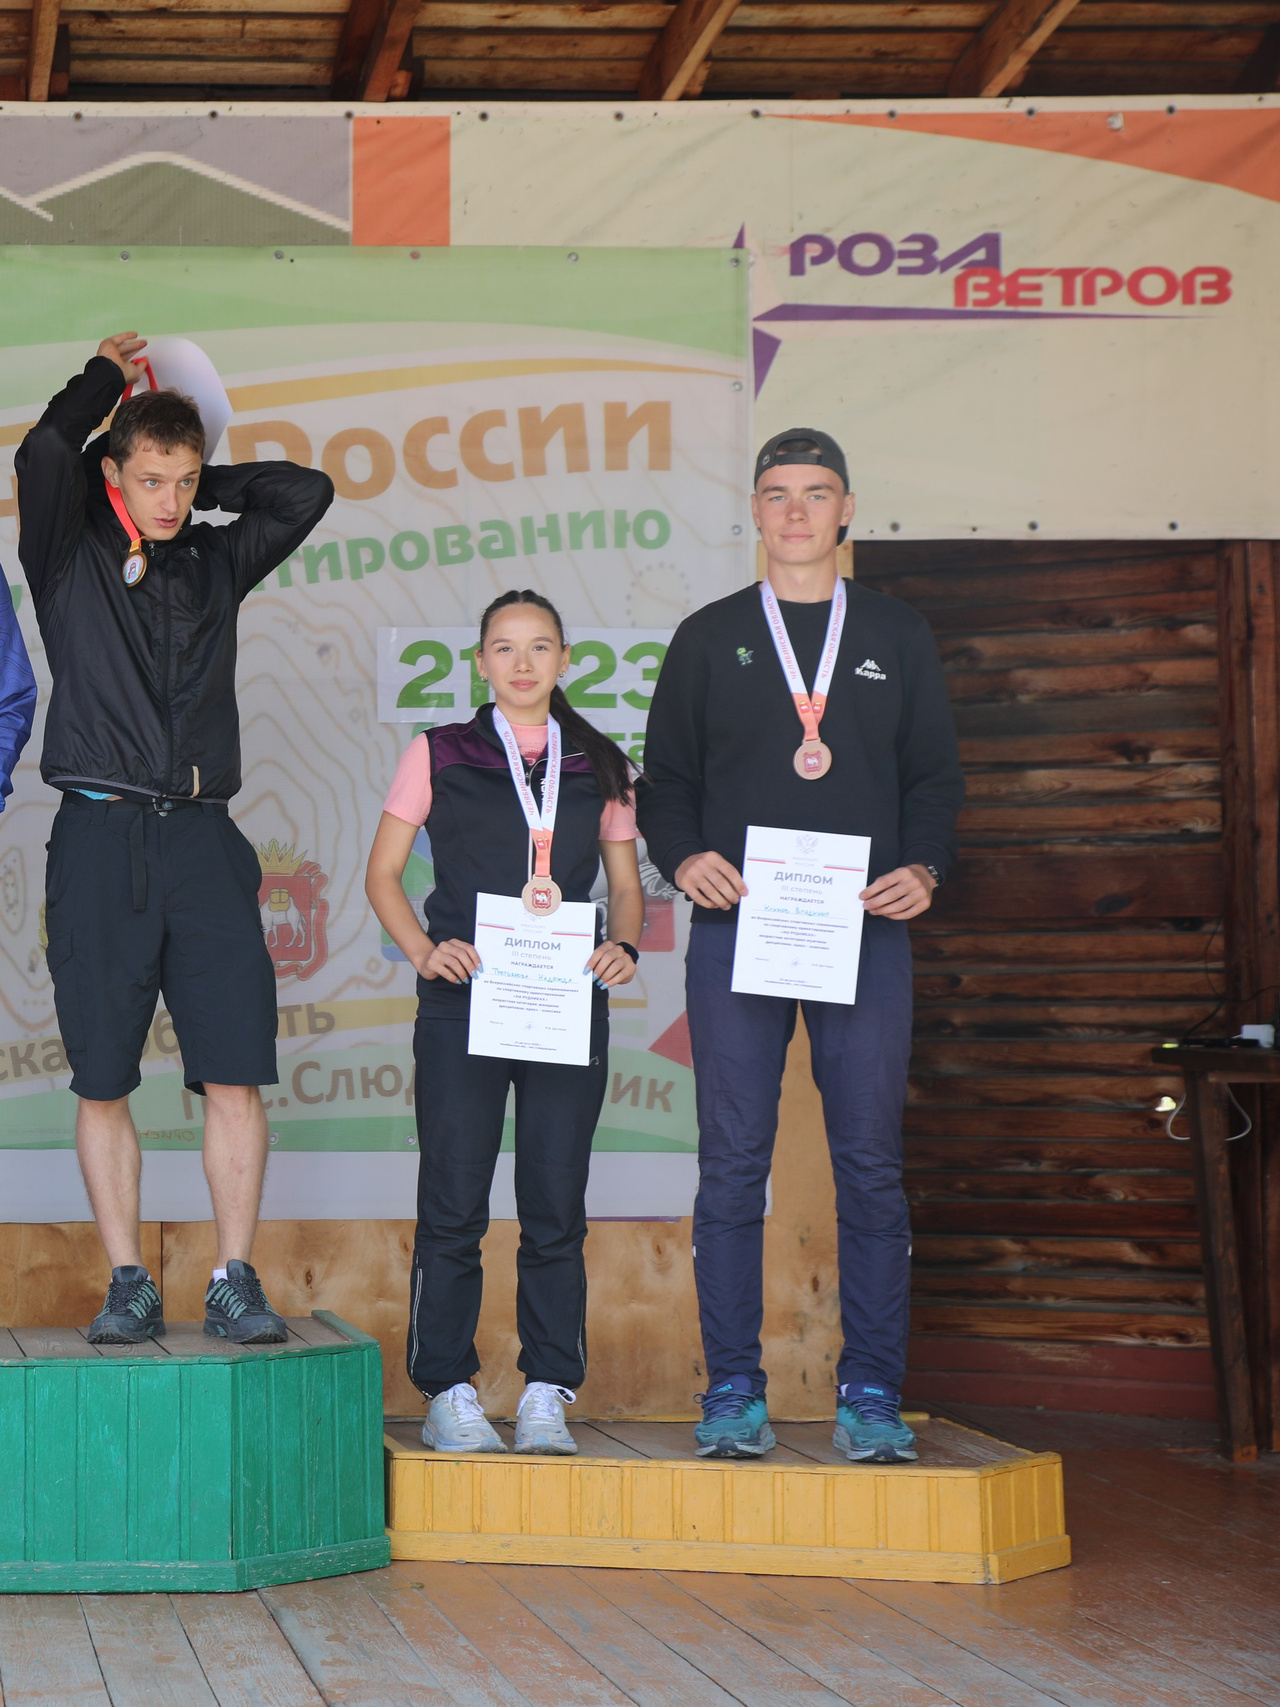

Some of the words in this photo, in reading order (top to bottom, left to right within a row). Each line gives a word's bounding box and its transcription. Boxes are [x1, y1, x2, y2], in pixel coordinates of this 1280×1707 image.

[788, 232, 1000, 276] РОЗА
[952, 266, 1233, 307] ВЕТРОВ
[776, 625, 796, 679] ЧЕЛЯБИНСКАЯ
[822, 643, 835, 678] ОБЛАСТЬ
[855, 666, 886, 680] Kappa
[504, 731, 518, 762] ОБЛАСТЬ
[546, 780, 556, 814] ОБЛАСТЬ
[774, 871, 833, 885] ДИПЛОМ
[780, 896, 824, 904] НАГРАЖДАЕТСЯ
[504, 937, 561, 951] ДИПЛОМ
[511, 961, 554, 969] НАГРАЖДАЕТСЯ
[863, 1387, 884, 1396] HOKA
